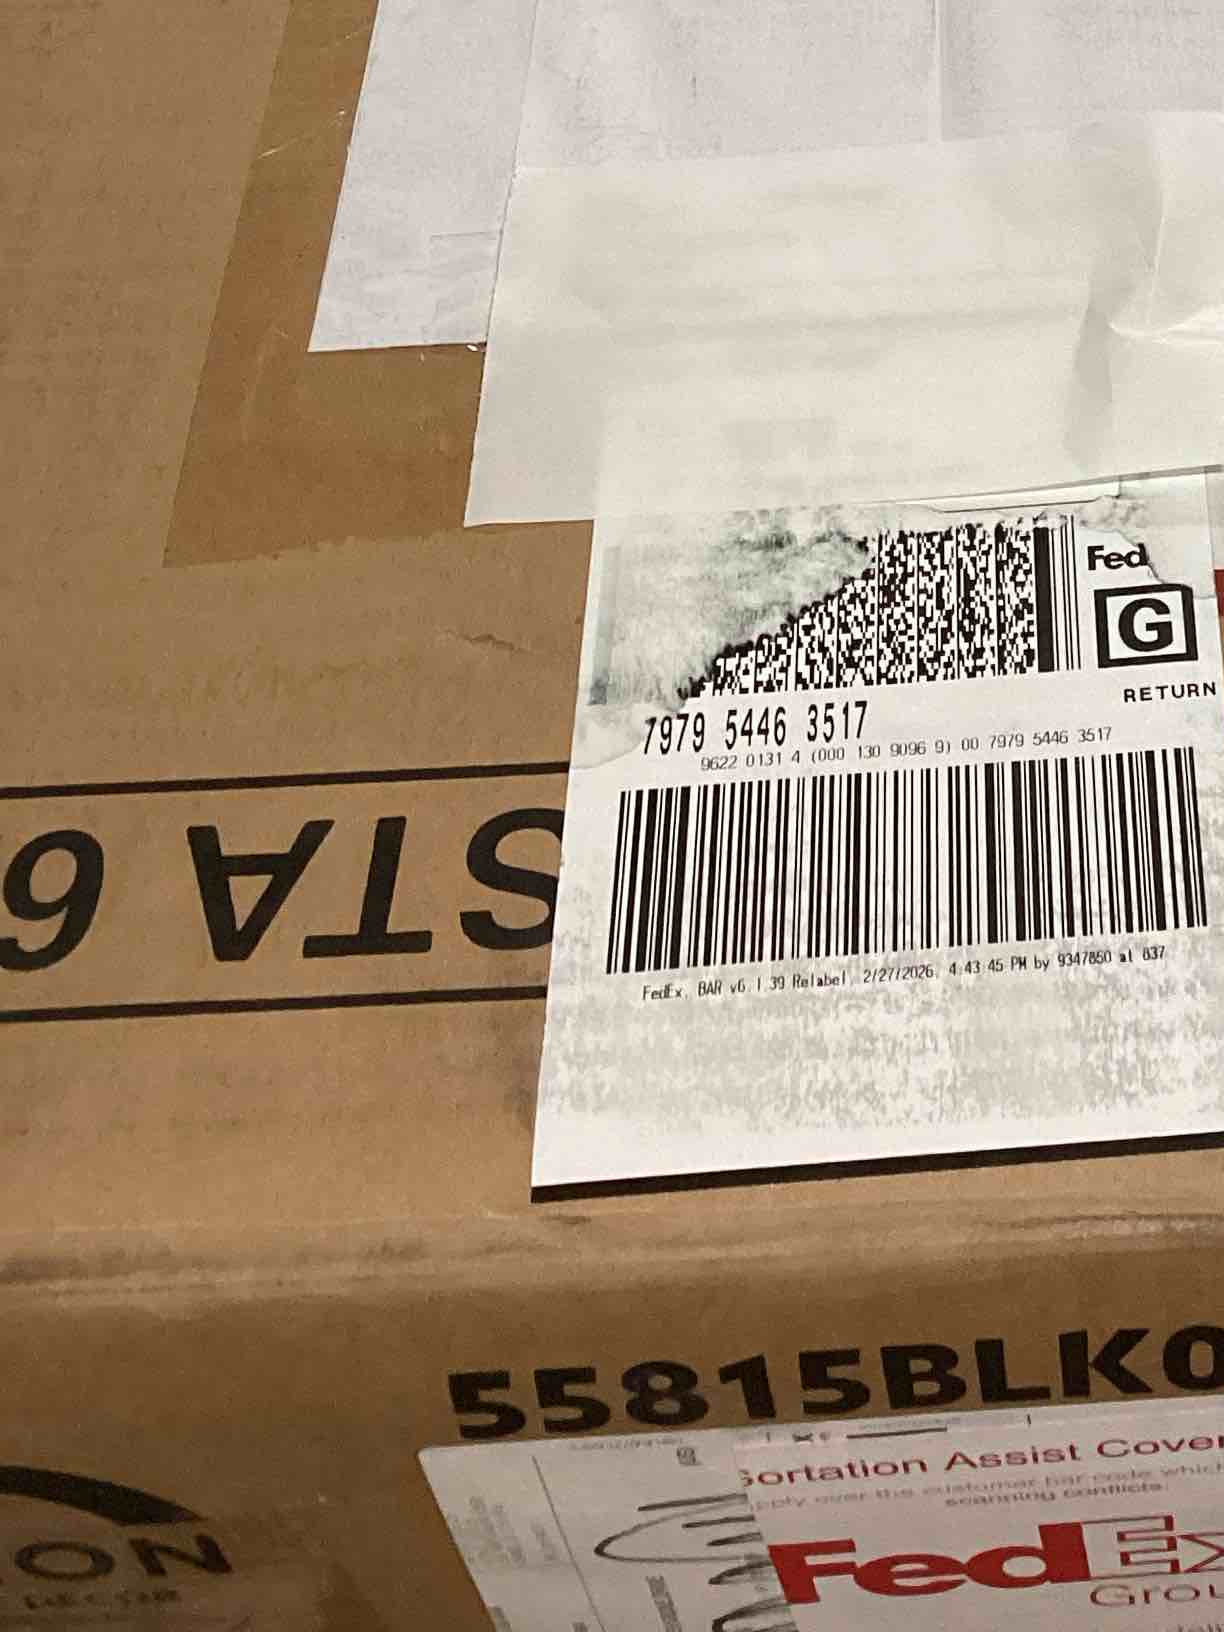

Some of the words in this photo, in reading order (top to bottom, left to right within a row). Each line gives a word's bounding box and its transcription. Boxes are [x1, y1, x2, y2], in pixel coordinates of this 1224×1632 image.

[1118, 597, 1174, 653] G
[1123, 681, 1217, 703] RETURN
[643, 712, 706, 755] 7979
[724, 706, 787, 750] 5446
[806, 699, 868, 743] 3517
[700, 754, 738, 772] 9622
[745, 751, 783, 768] 0131
[791, 749, 801, 764] 4
[856, 744, 882, 759] 130
[889, 740, 927, 757] 9096
[961, 736, 980, 752] 00
[989, 733, 1025, 750] 7979
[1032, 729, 1069, 747] 5446
[1077, 725, 1113, 744] 3517
[0, 828, 105, 973] 6
[185, 807, 564, 963] STA
[698, 978, 723, 998] BAR
[1010, 956, 1027, 972] PM
[1034, 955, 1050, 972] by
[1119, 948, 1133, 964] at
[944, 1442, 1081, 1473] Assist
[0, 1534, 233, 1581] ON
